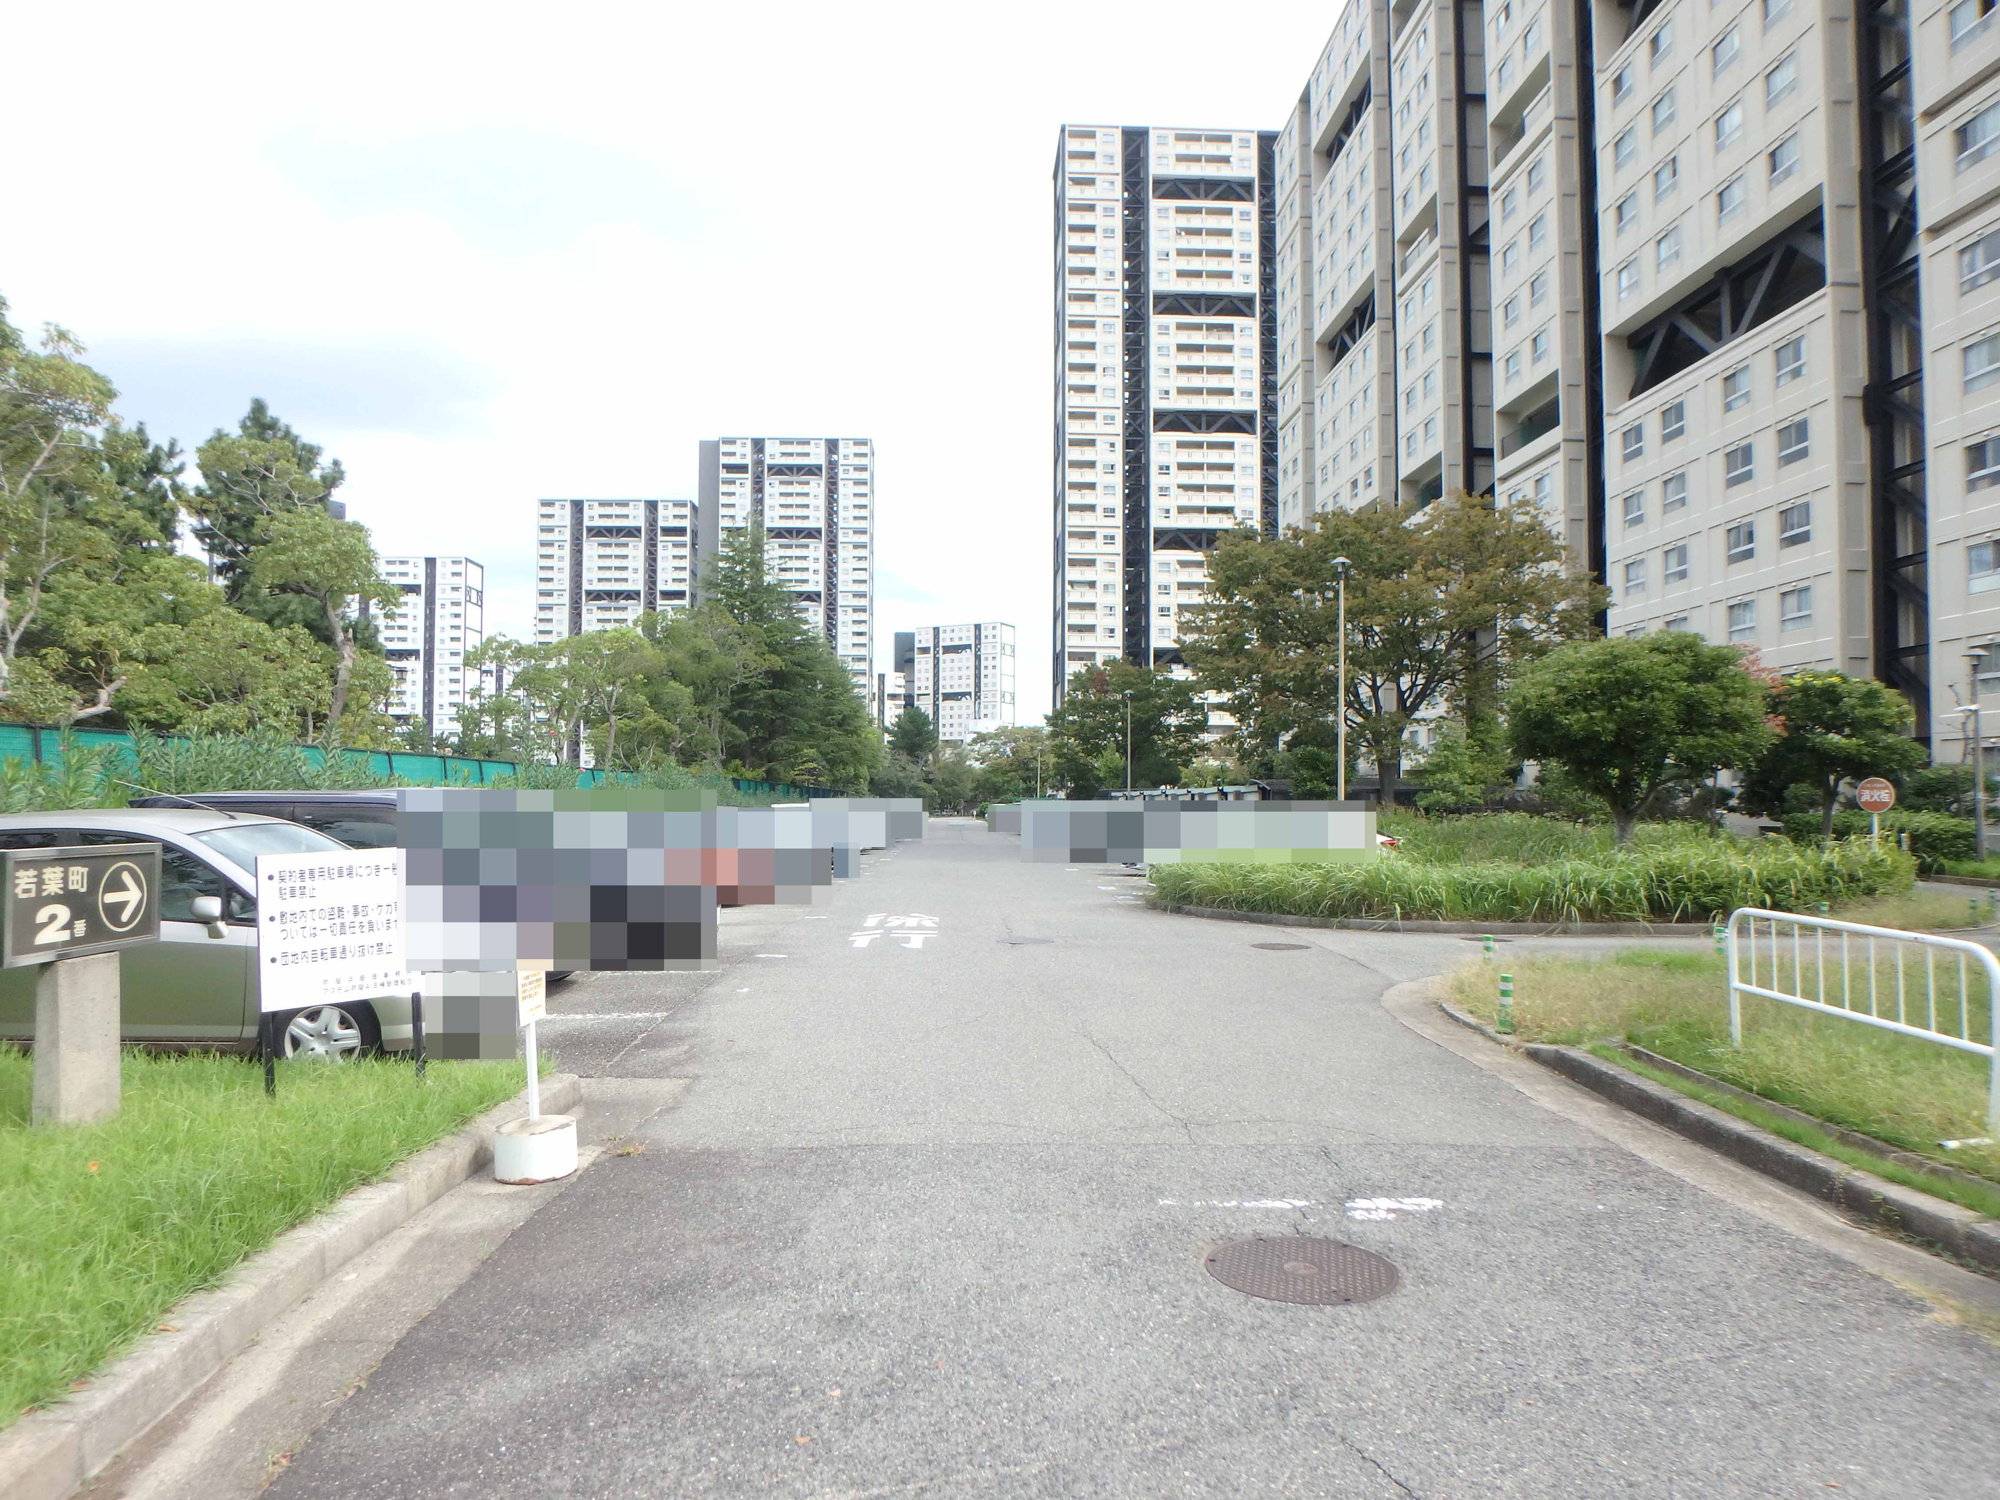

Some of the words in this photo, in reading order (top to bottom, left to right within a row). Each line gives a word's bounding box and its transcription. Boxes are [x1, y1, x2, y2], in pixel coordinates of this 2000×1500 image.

[1860, 789, 1891, 802] 消火栓
[14, 865, 89, 899] 若葉町
[278, 885, 316, 900] 駐車禁止
[34, 904, 87, 945] 2番
[848, 912, 940, 948] 徐行
